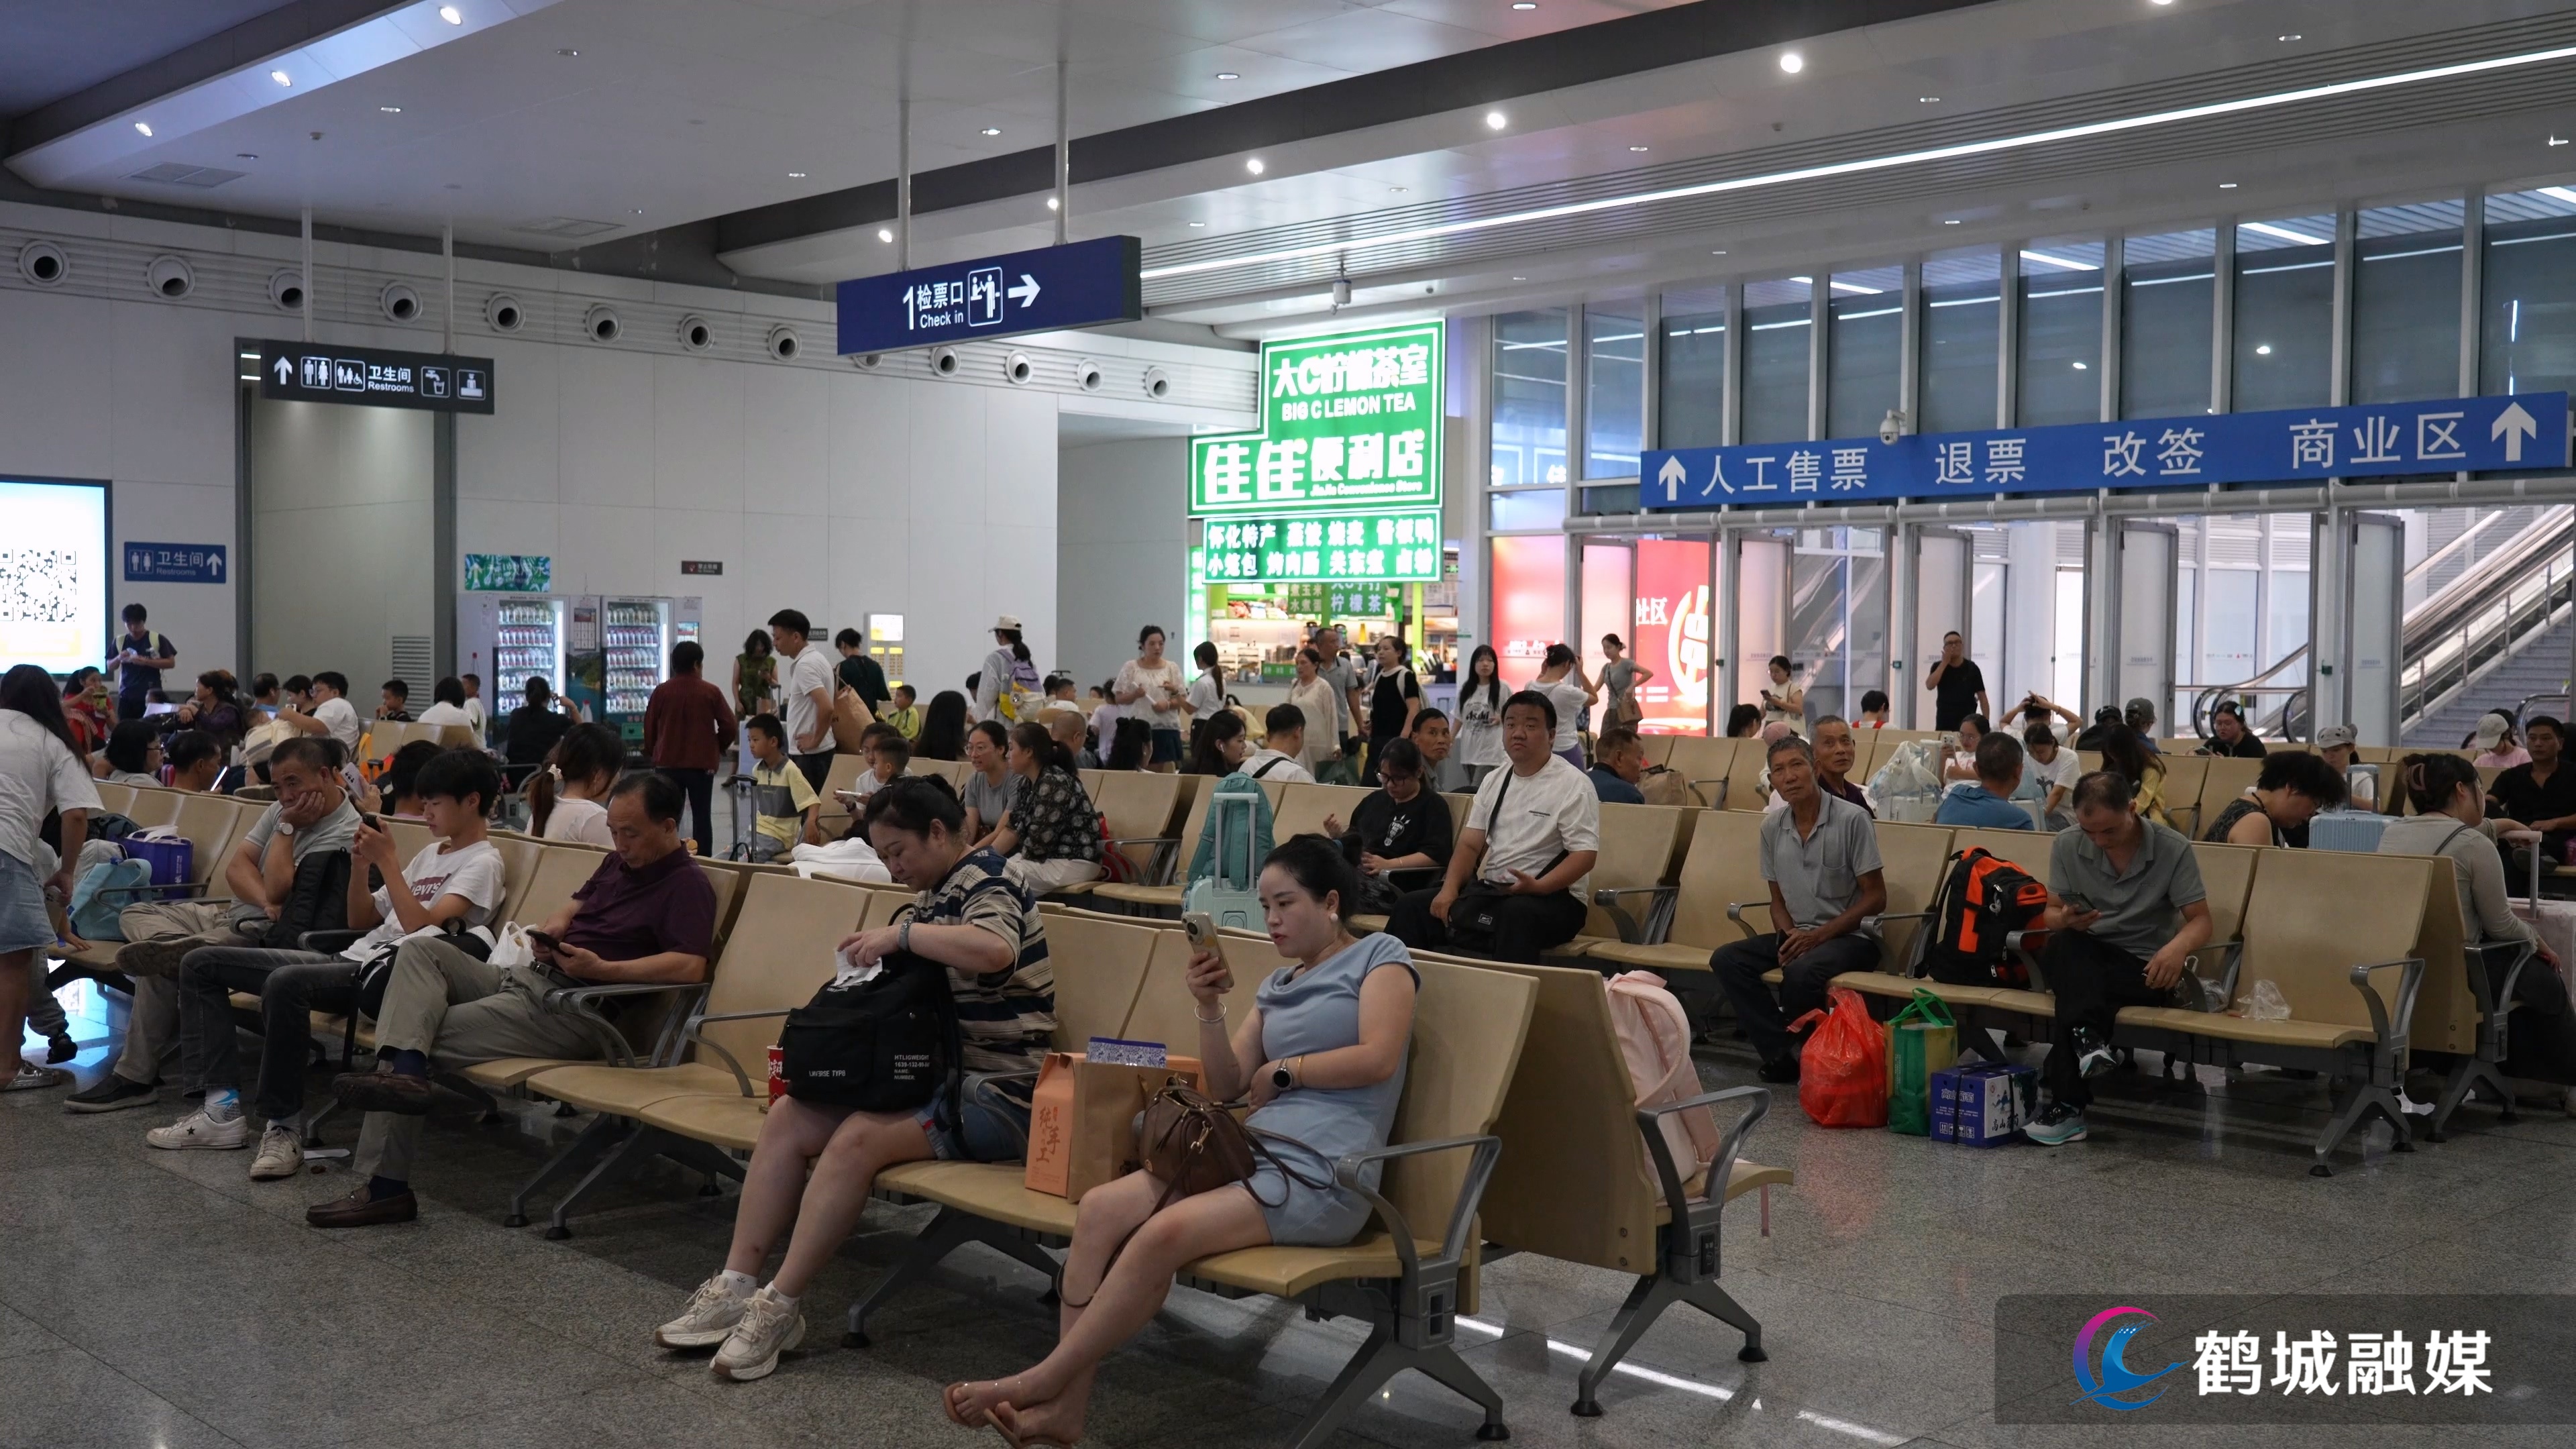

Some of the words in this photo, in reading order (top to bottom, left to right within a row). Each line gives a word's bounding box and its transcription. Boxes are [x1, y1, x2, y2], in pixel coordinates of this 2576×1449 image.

[903, 285, 914, 330] 1
[916, 282, 963, 311] 检票口
[920, 313, 951, 329] Check
[954, 310, 964, 324] in
[368, 366, 411, 383] 卫生间
[1273, 343, 1429, 398] 大C柠檬茶室
[368, 381, 415, 393] Restrooms
[1282, 402, 1309, 421] BIG
[1311, 400, 1322, 419] C
[1324, 395, 1380, 418] LEMON
[1383, 392, 1416, 413] TEA
[1701, 447, 1868, 496] 人工售票
[1935, 438, 2026, 486] 退票
[2102, 427, 2204, 478] 改签
[2288, 411, 2467, 470] 商业区
[1203, 429, 1426, 503] 佳佳便利店
[1208, 523, 1276, 549] 怀化特产
[157, 551, 204, 568] 卫生间
[1208, 552, 1258, 577] 小笼包
[1329, 549, 1385, 575] 关东煮
[156, 568, 197, 576] Restrooms
[1331, 593, 1382, 613] 柠檬茶
[411, 882, 441, 896] evi's
